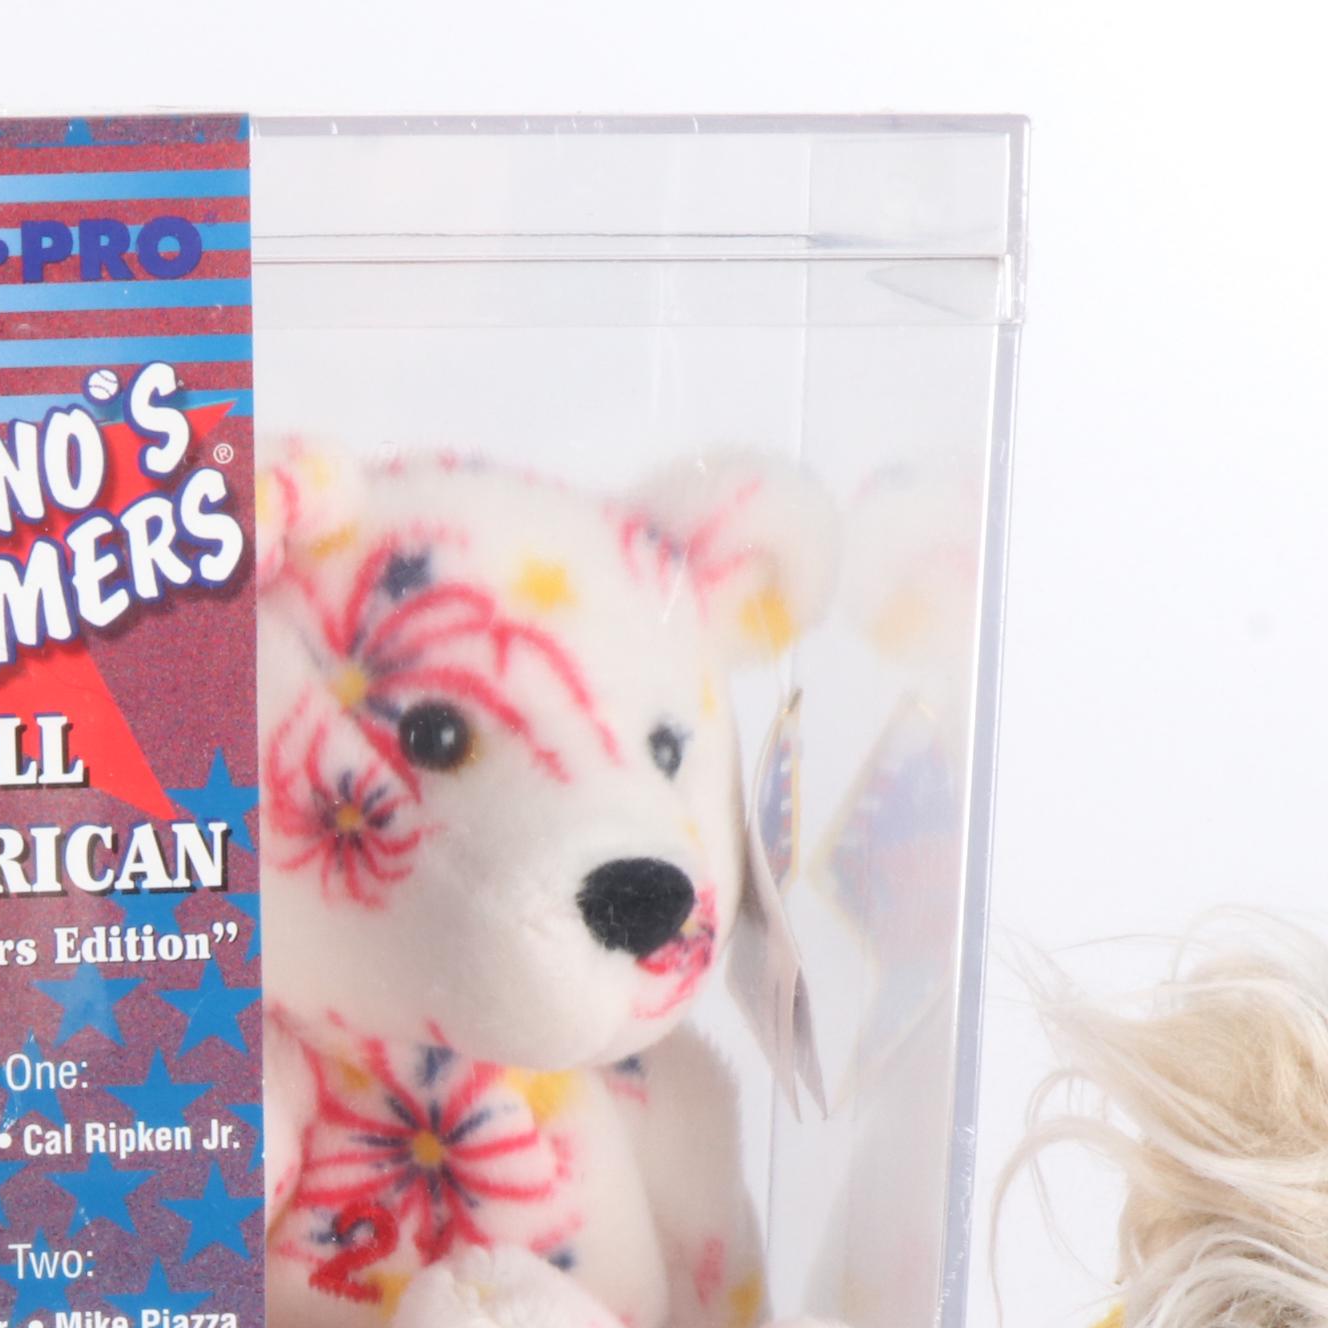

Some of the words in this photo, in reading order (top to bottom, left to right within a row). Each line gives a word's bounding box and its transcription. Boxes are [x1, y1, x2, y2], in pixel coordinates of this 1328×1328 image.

[5, 1053, 89, 1092] One:
[23, 1123, 74, 1156] Cal
[84, 1121, 193, 1160] Ripken
[202, 1118, 241, 1151] Jr.
[8, 1243, 94, 1280] Two:
[308, 1201, 399, 1305] 2
